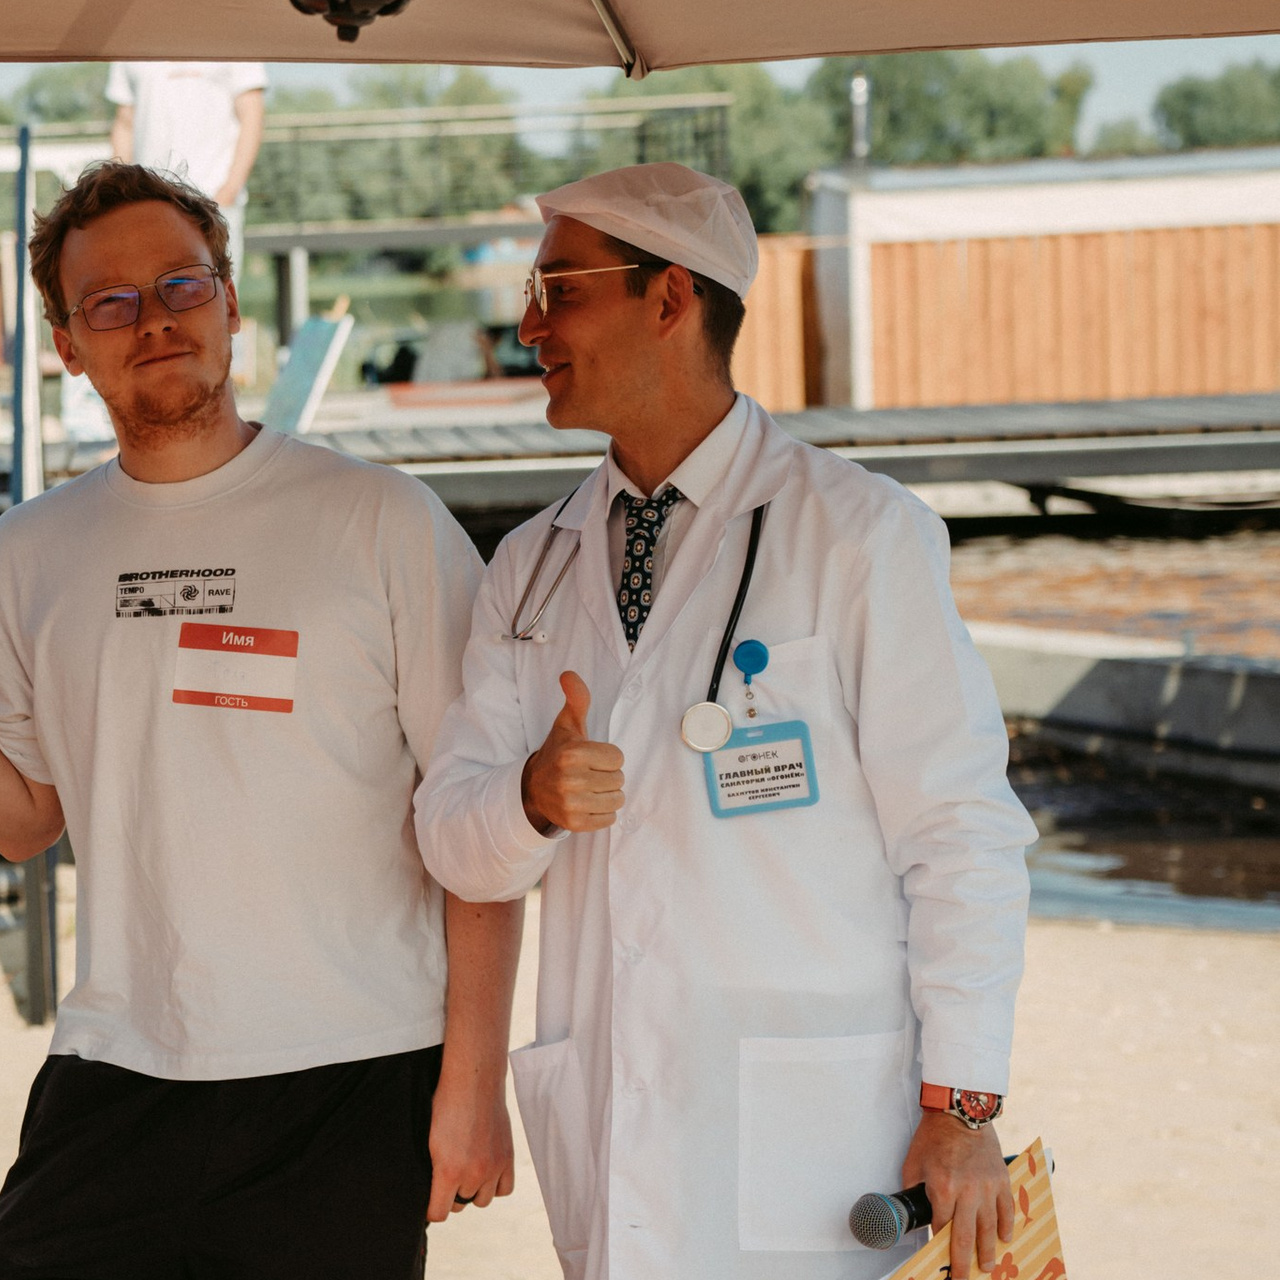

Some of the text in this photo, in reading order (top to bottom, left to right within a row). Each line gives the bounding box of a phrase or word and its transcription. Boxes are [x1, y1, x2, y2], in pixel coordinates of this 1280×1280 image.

[118, 568, 236, 582] BROTHERHOOD
[119, 586, 145, 595] TEMPO
[208, 588, 231, 596] RAVE
[221, 631, 255, 646] Имя
[214, 695, 249, 708] ГОСТЬ
[719, 762, 803, 780] ГЛАВНЫЙ ВРАЧ
[720, 777, 766, 789] САНАТОРИЯ
[760, 783, 801, 793] КОНСТАНТИН
[748, 792, 781, 800] СЕРГЕЕВИЧ
